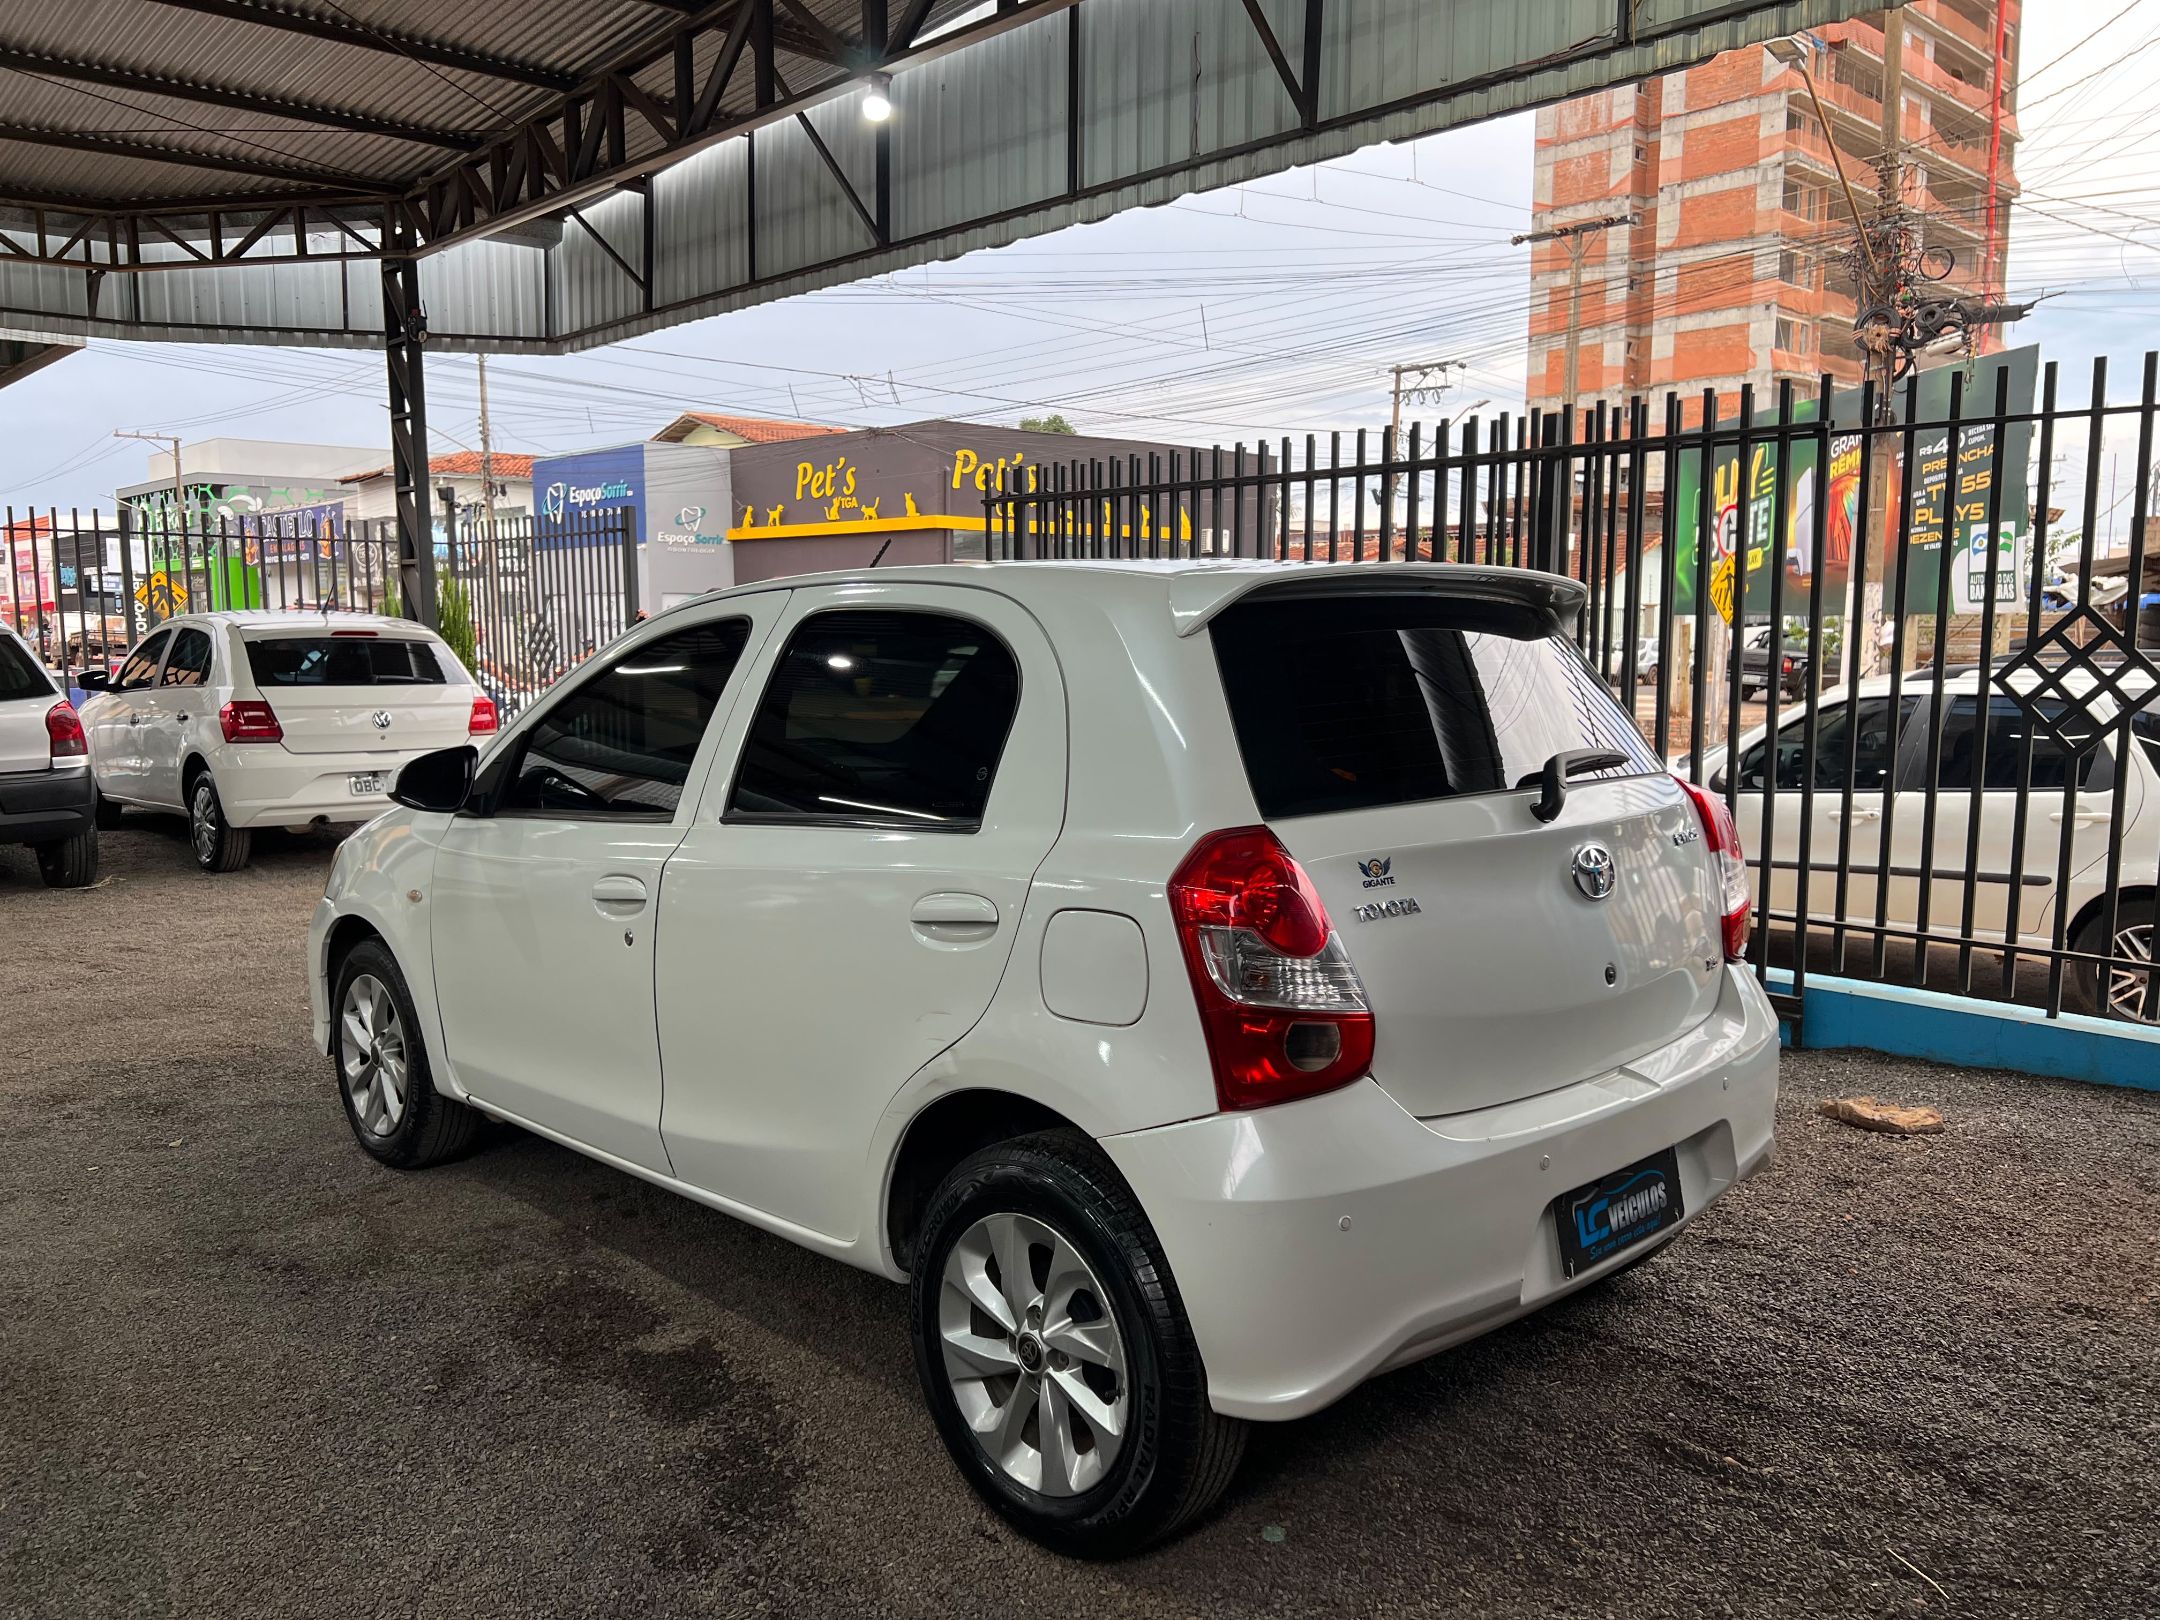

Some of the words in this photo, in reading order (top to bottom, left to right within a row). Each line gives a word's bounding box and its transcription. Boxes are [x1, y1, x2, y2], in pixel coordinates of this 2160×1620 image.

[1829, 447, 1862, 480] RÊMI
[1922, 443, 1994, 474] PRENCHA
[796, 457, 857, 500] Pet's
[569, 479, 629, 507] EspaçoSorrir
[841, 497, 858, 509] TGA
[1915, 502, 1985, 525] PLY5
[657, 531, 724, 546] EspaçoSorrir
[1910, 528, 1961, 545] EZENS
[1970, 583, 2015, 601] BANRAS
[1362, 876, 1396, 888] GIGANTE
[1354, 897, 1422, 922] TOYOTA
[1576, 1198, 1610, 1249] LC
[1608, 1181, 1668, 1233] VEÍCULOS
[1133, 1383, 1157, 1481] RADIAL
